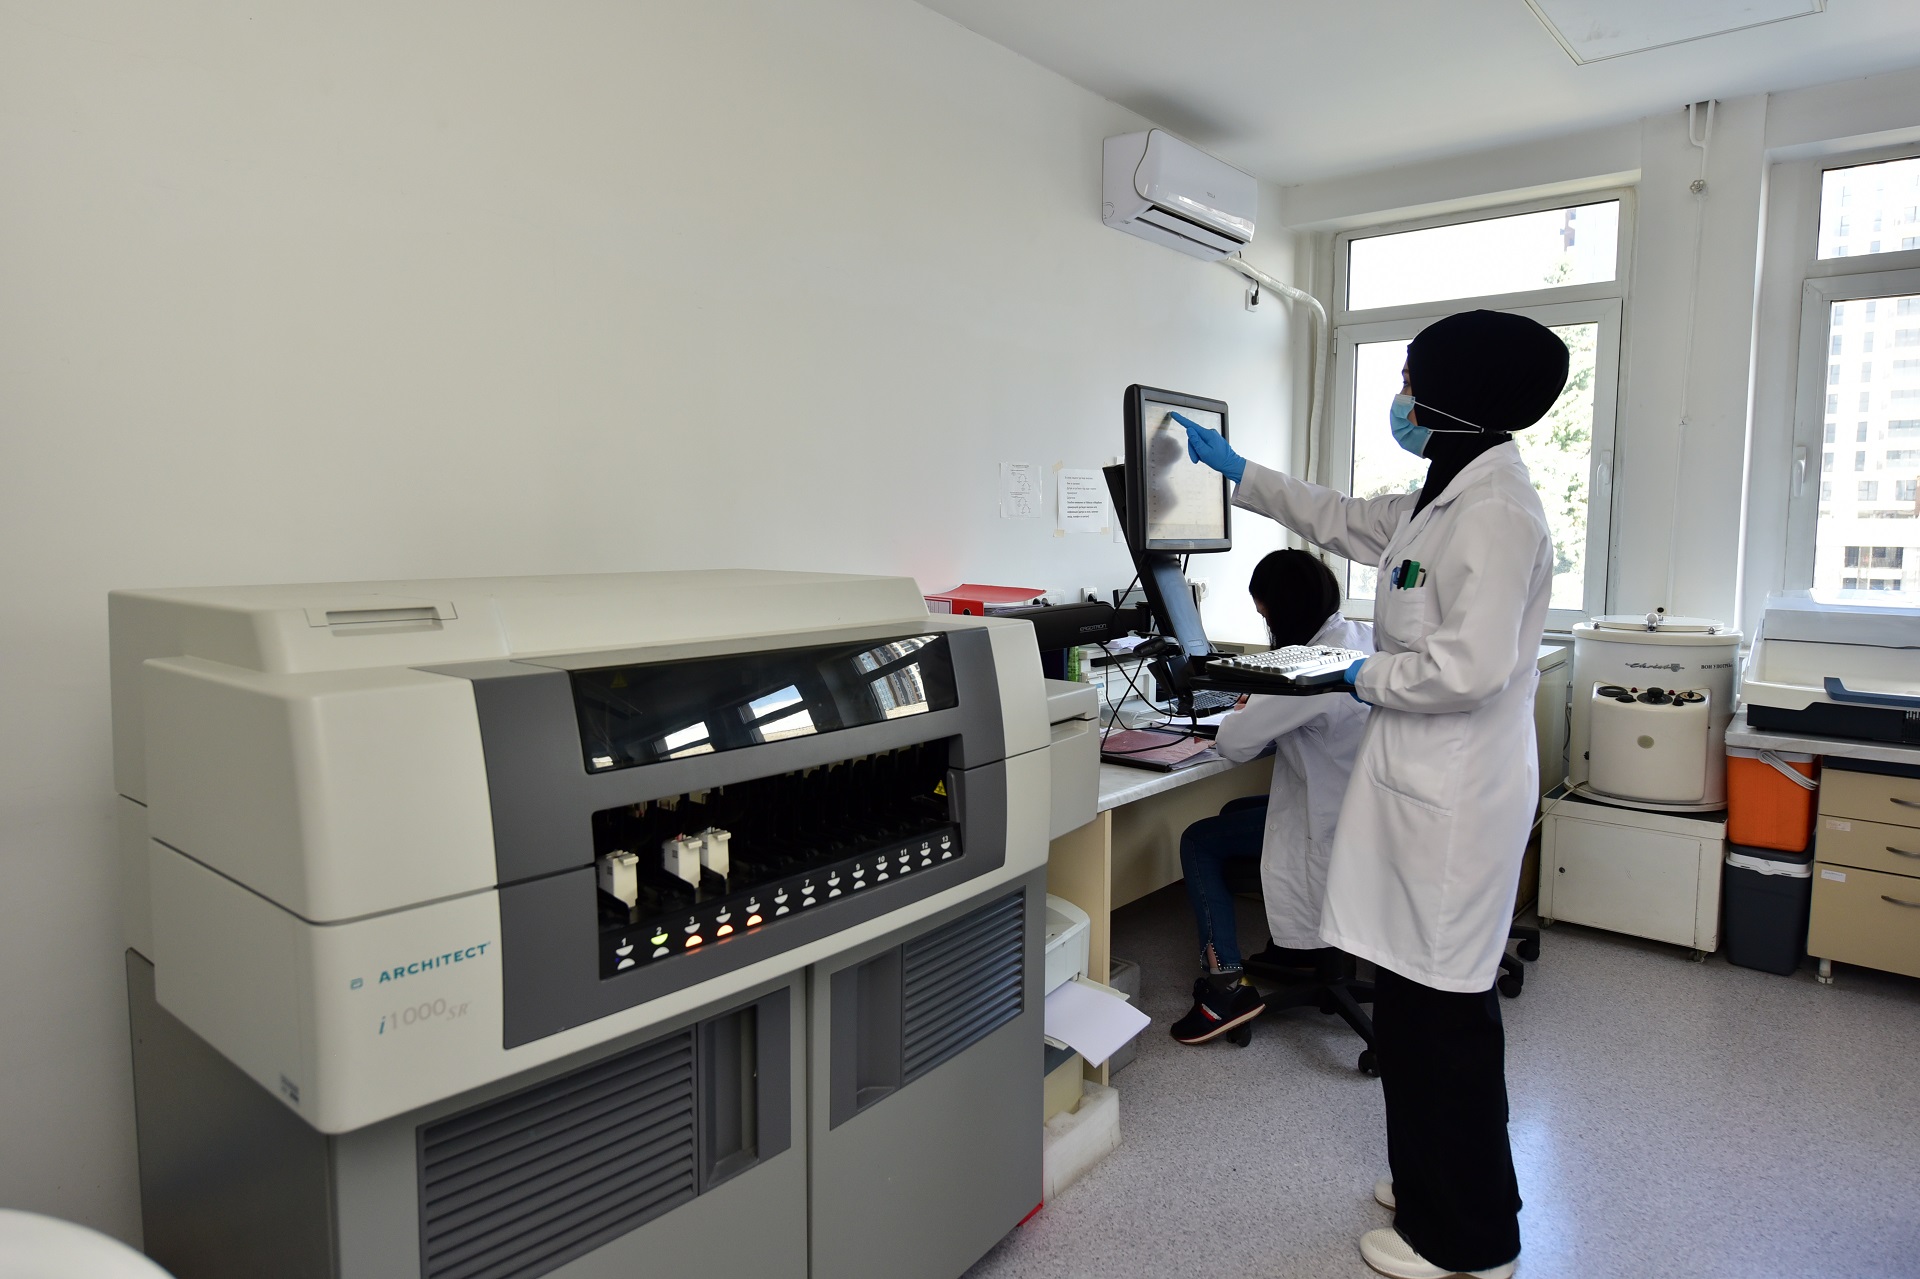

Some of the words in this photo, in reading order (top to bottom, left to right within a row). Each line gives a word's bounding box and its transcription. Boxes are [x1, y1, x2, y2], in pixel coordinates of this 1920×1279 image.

[621, 937, 627, 947] 1
[656, 926, 663, 935] 2
[689, 916, 695, 925] 3
[720, 906, 726, 914] 4
[750, 896, 756, 905] 5
[778, 887, 784, 896] 6
[805, 879, 810, 887] 7
[855, 863, 861, 871] 9
[877, 855, 885, 863] 10
[900, 848, 907, 856] 11
[921, 841, 929, 849] 12
[942, 835, 949, 843] 13
[379, 943, 487, 984] ARCHITECT
